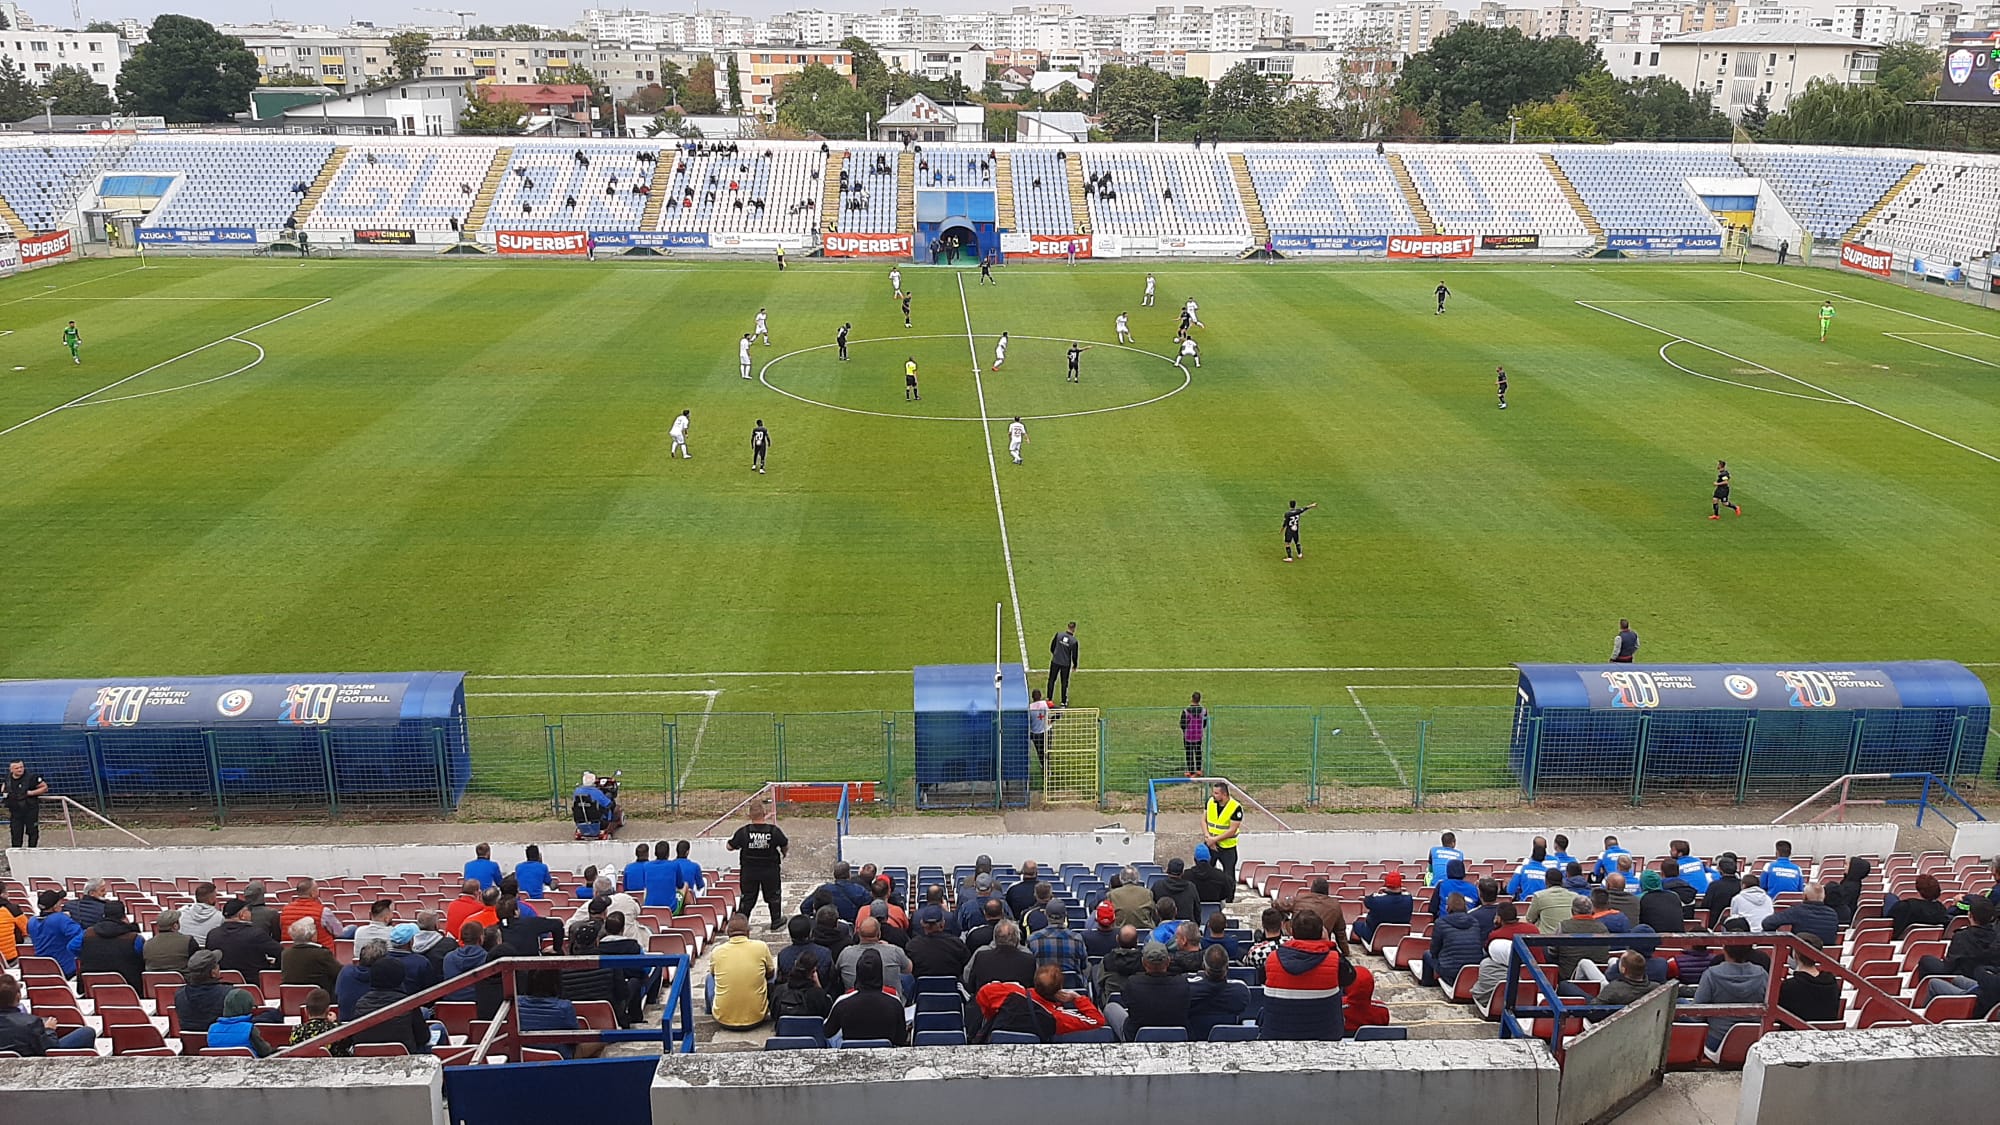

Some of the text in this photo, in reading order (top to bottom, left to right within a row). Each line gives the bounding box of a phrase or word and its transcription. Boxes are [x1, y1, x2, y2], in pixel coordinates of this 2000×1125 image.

[1976, 53, 1986, 67] 0
[21, 233, 70, 257] SUPERBET
[498, 234, 585, 251] SUPERBET
[676, 236, 705, 244] AZUGA
[826, 236, 910, 253] SUPERBET
[1029, 238, 1089, 254] PERBET
[1390, 238, 1473, 254] SUPERBET
[1843, 246, 1891, 269] SUPERBET
[336, 695, 390, 703] FOOTBALL
[749, 832, 772, 840] WMC
